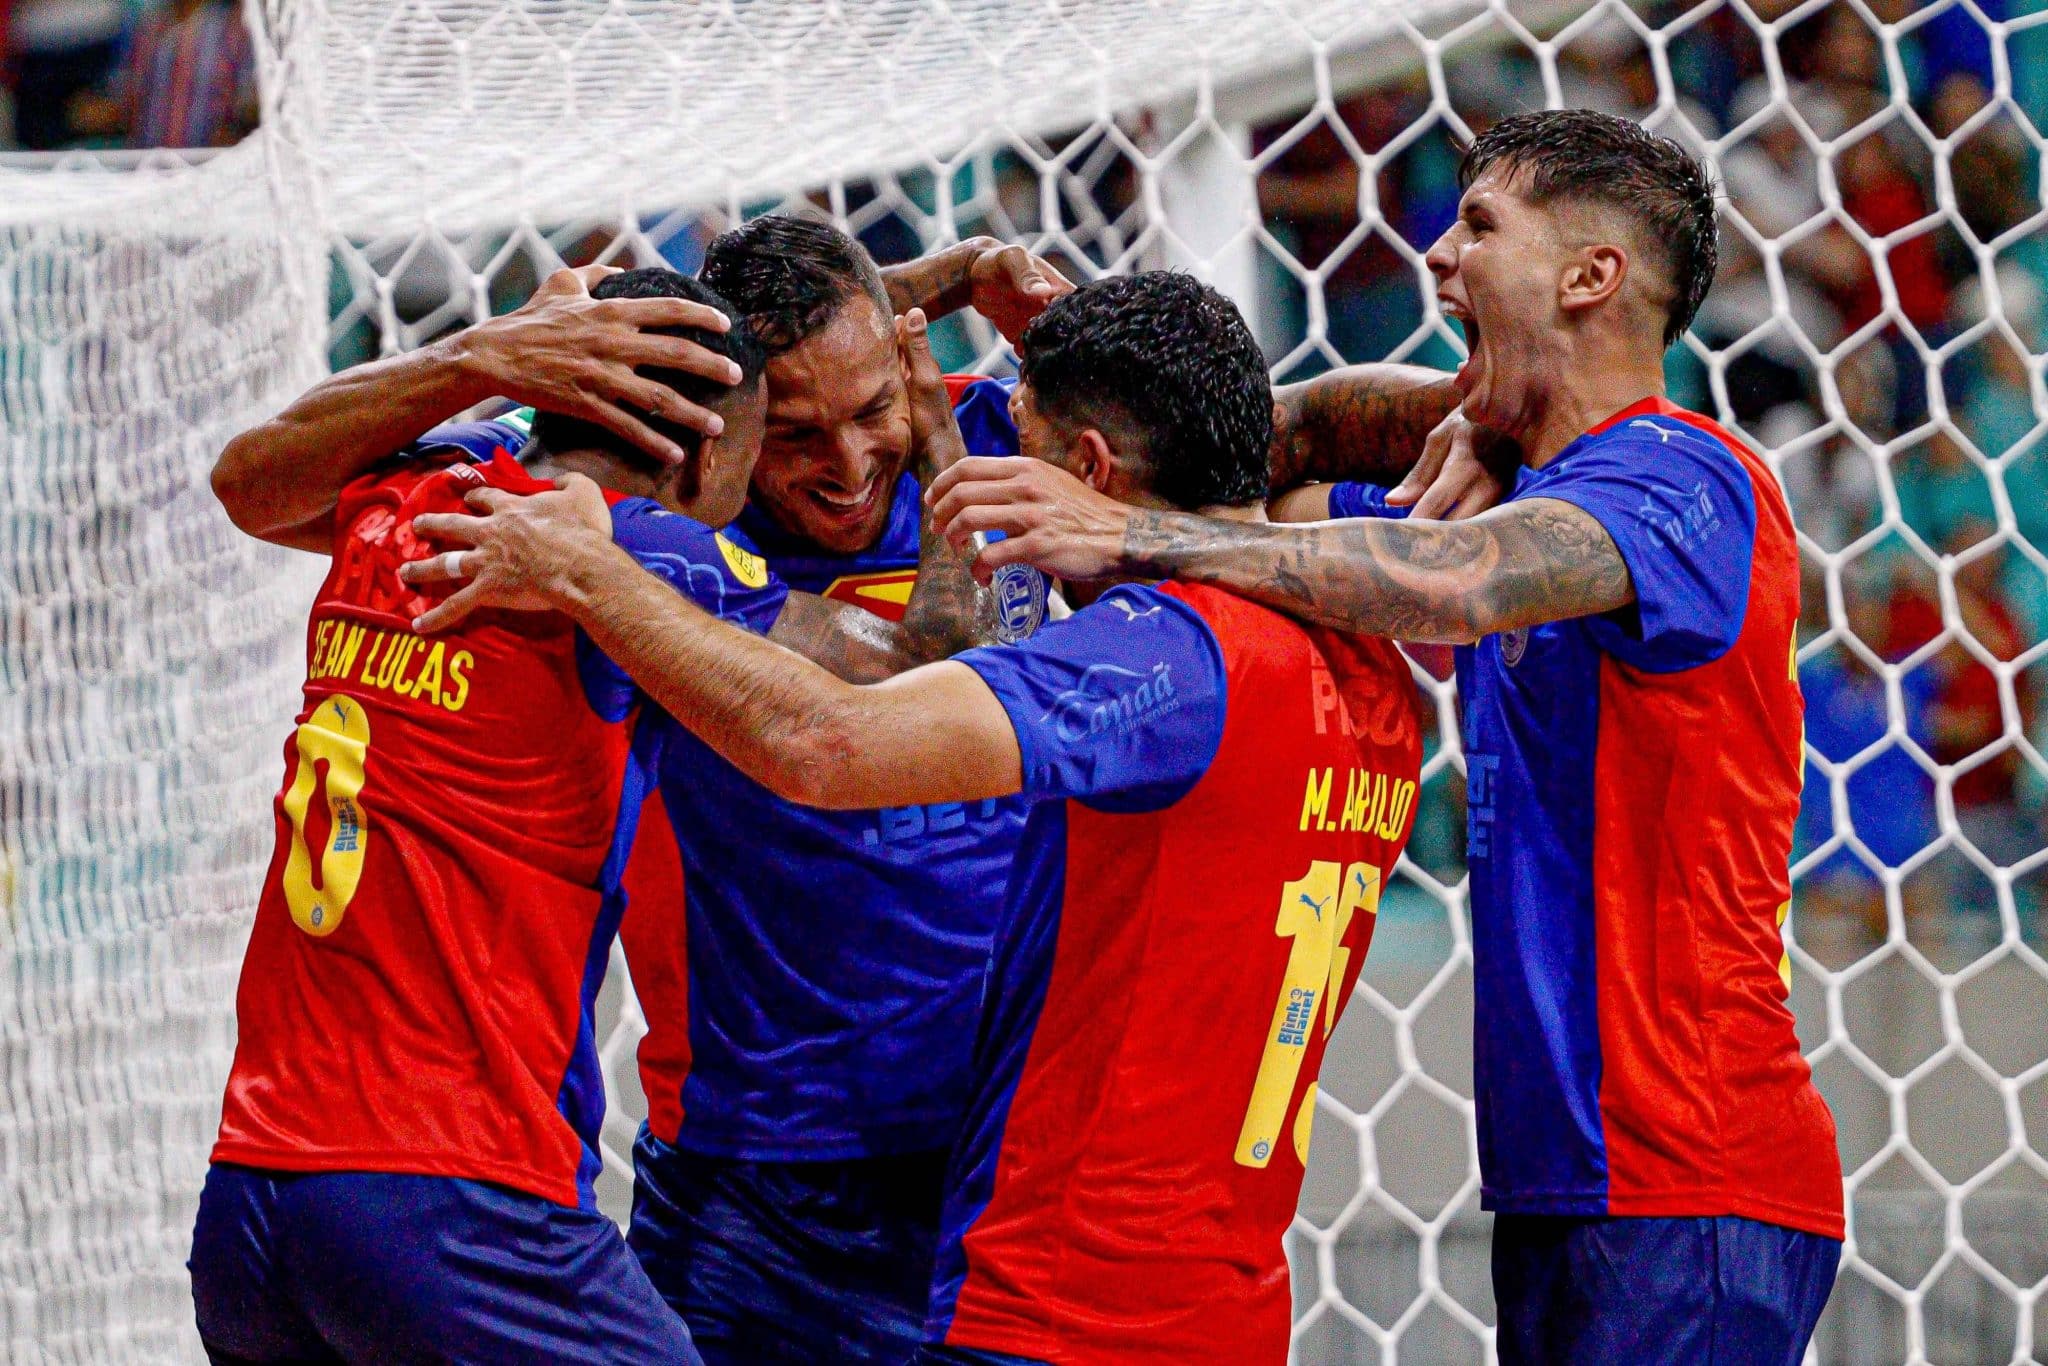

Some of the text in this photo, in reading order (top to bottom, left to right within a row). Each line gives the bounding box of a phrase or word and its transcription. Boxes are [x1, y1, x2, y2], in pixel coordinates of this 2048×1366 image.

[309, 619, 475, 712] JEAN LUCAS
[1056, 661, 1176, 744] Canaã
[1299, 766, 1337, 832] M.
[1292, 989, 1316, 1046] planet
